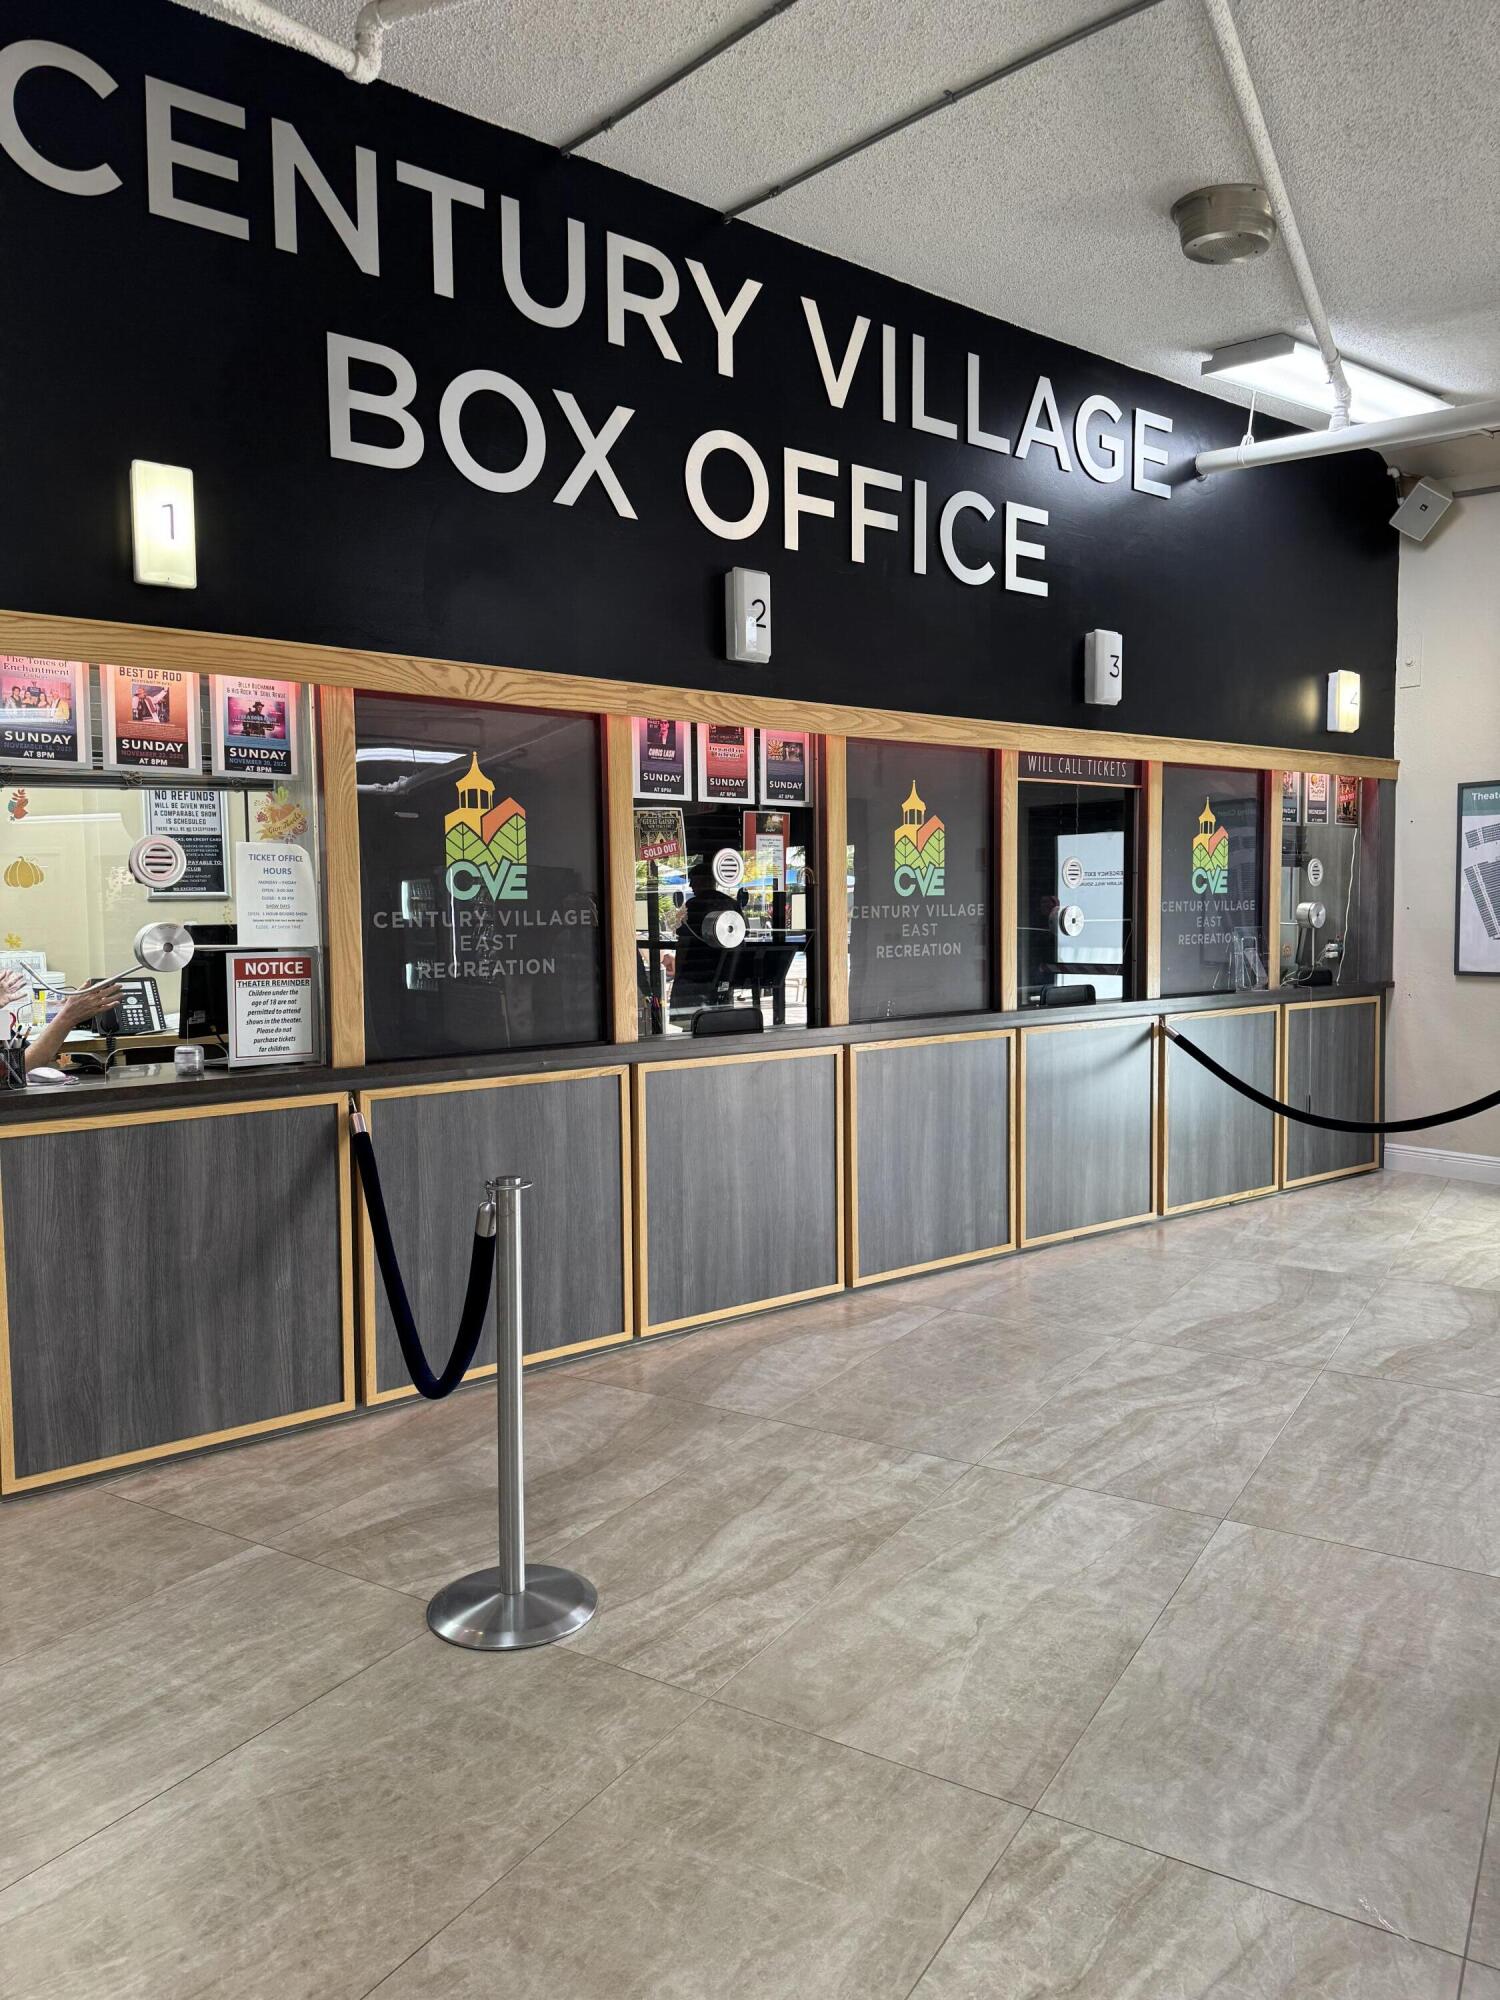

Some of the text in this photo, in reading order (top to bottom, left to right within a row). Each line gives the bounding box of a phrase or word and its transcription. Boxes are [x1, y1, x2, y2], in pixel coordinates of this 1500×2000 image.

[0, 39, 1173, 499] CENTURY VILLAGE
[326, 331, 1048, 597] BOX OFFICE
[162, 504, 174, 540] 1
[752, 599, 767, 628] 2
[3, 662, 69, 676] Enchantment
[1109, 655, 1120, 678] 3
[119, 667, 182, 682] BEST OF ROD
[4, 731, 72, 745] SUNDAY
[122, 739, 183, 753] SUNDAY
[229, 747, 286, 760] SUNDAY
[36, 751, 55, 759] 8PM
[1028, 755, 1127, 777] WILL CALL TICKETS
[643, 772, 681, 783] SUNDAY
[709, 777, 745, 787] SUNDAY
[769, 780, 803, 790] SUNDAY
[154, 790, 215, 801] NO REFUNDS
[248, 853, 304, 863] TICKET OFFICE
[643, 842, 677, 859] SOLD OUT
[263, 867, 292, 875] HOURS
[445, 858, 528, 901] CVE
[894, 862, 945, 897] CVE
[1192, 864, 1229, 895] CVE
[850, 903, 985, 919] CENTURY VILLAGE
[1161, 899, 1256, 912] CENTURY VILLAGE
[373, 909, 592, 929] CENTURY VILLAGE
[1196, 916, 1222, 928] EAST
[902, 923, 938, 937] EAST
[460, 934, 518, 952] EAST
[876, 943, 961, 959] RECREATION
[245, 961, 304, 976] NOTICE
[418, 958, 556, 979] RECREATION
[237, 979, 310, 988] THEATER REMINDER
[247, 1008, 275, 1017] permitted
